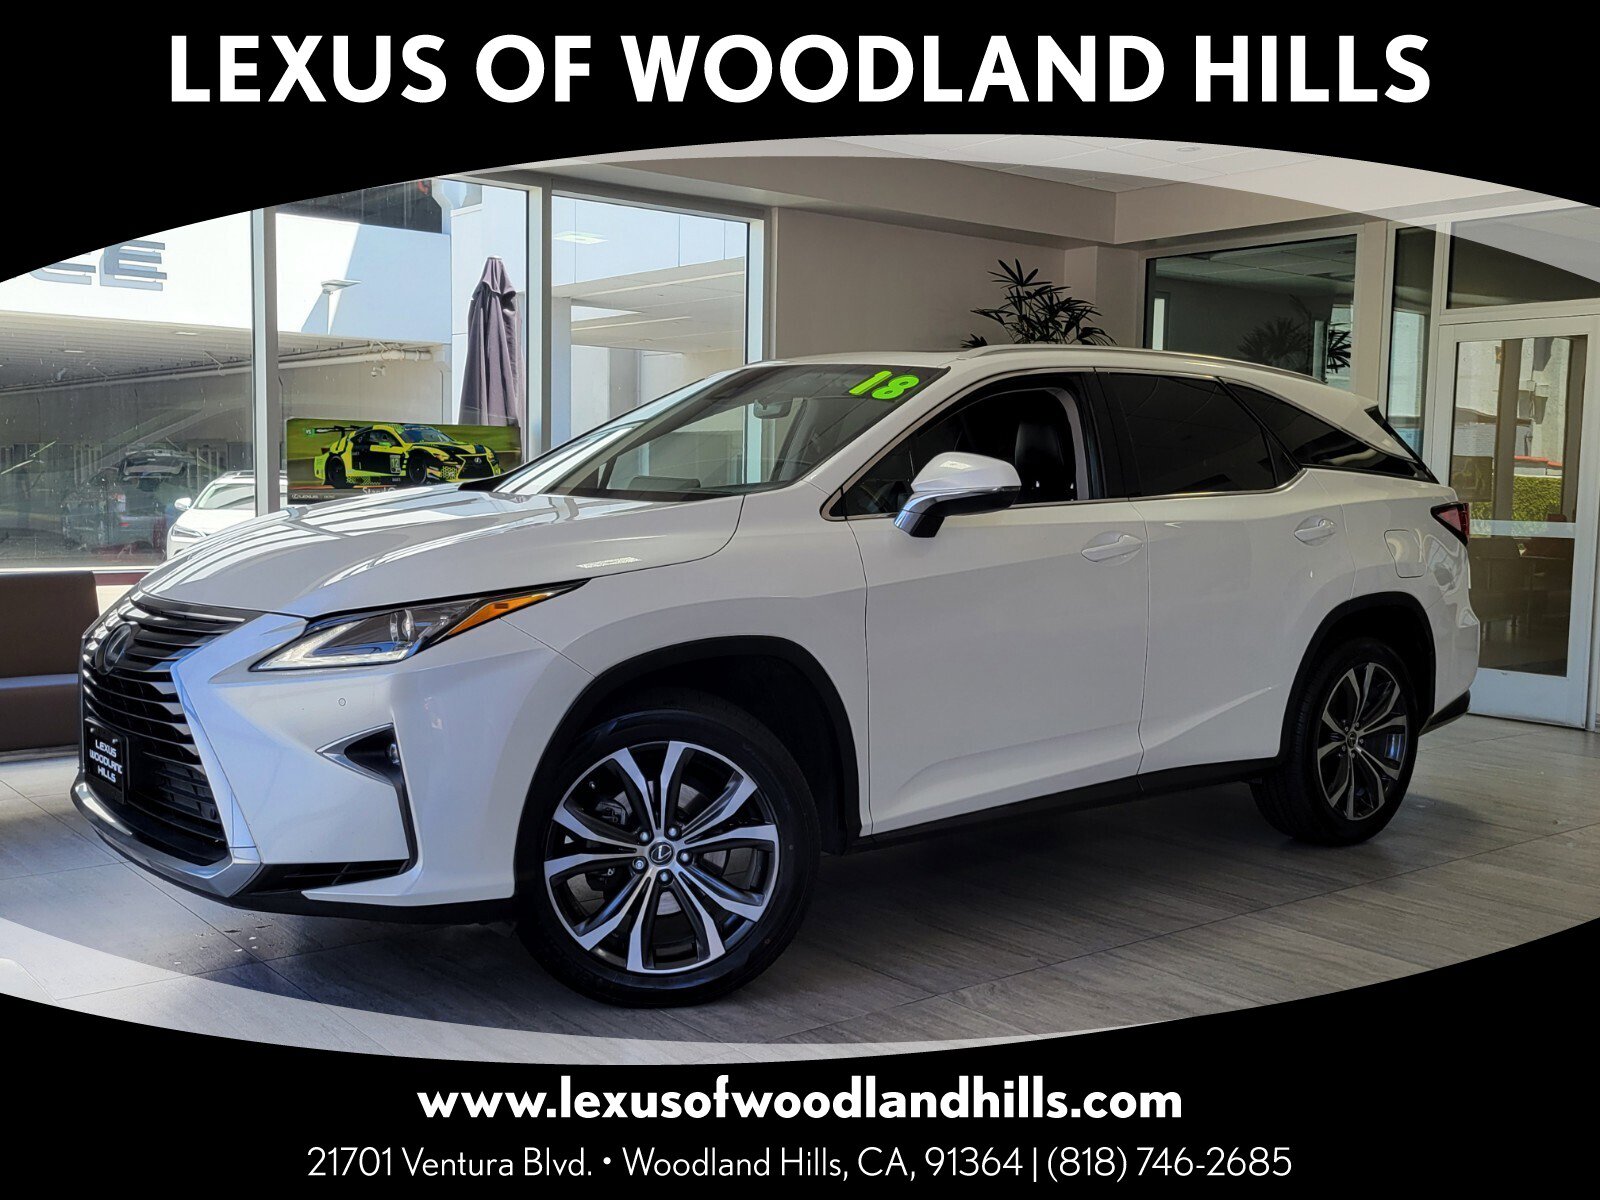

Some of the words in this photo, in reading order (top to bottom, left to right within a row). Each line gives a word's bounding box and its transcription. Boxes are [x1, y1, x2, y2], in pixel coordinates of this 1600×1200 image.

[849, 370, 920, 400] 18
[95, 739, 117, 758] LEXUS
[97, 765, 117, 783] HILLS
